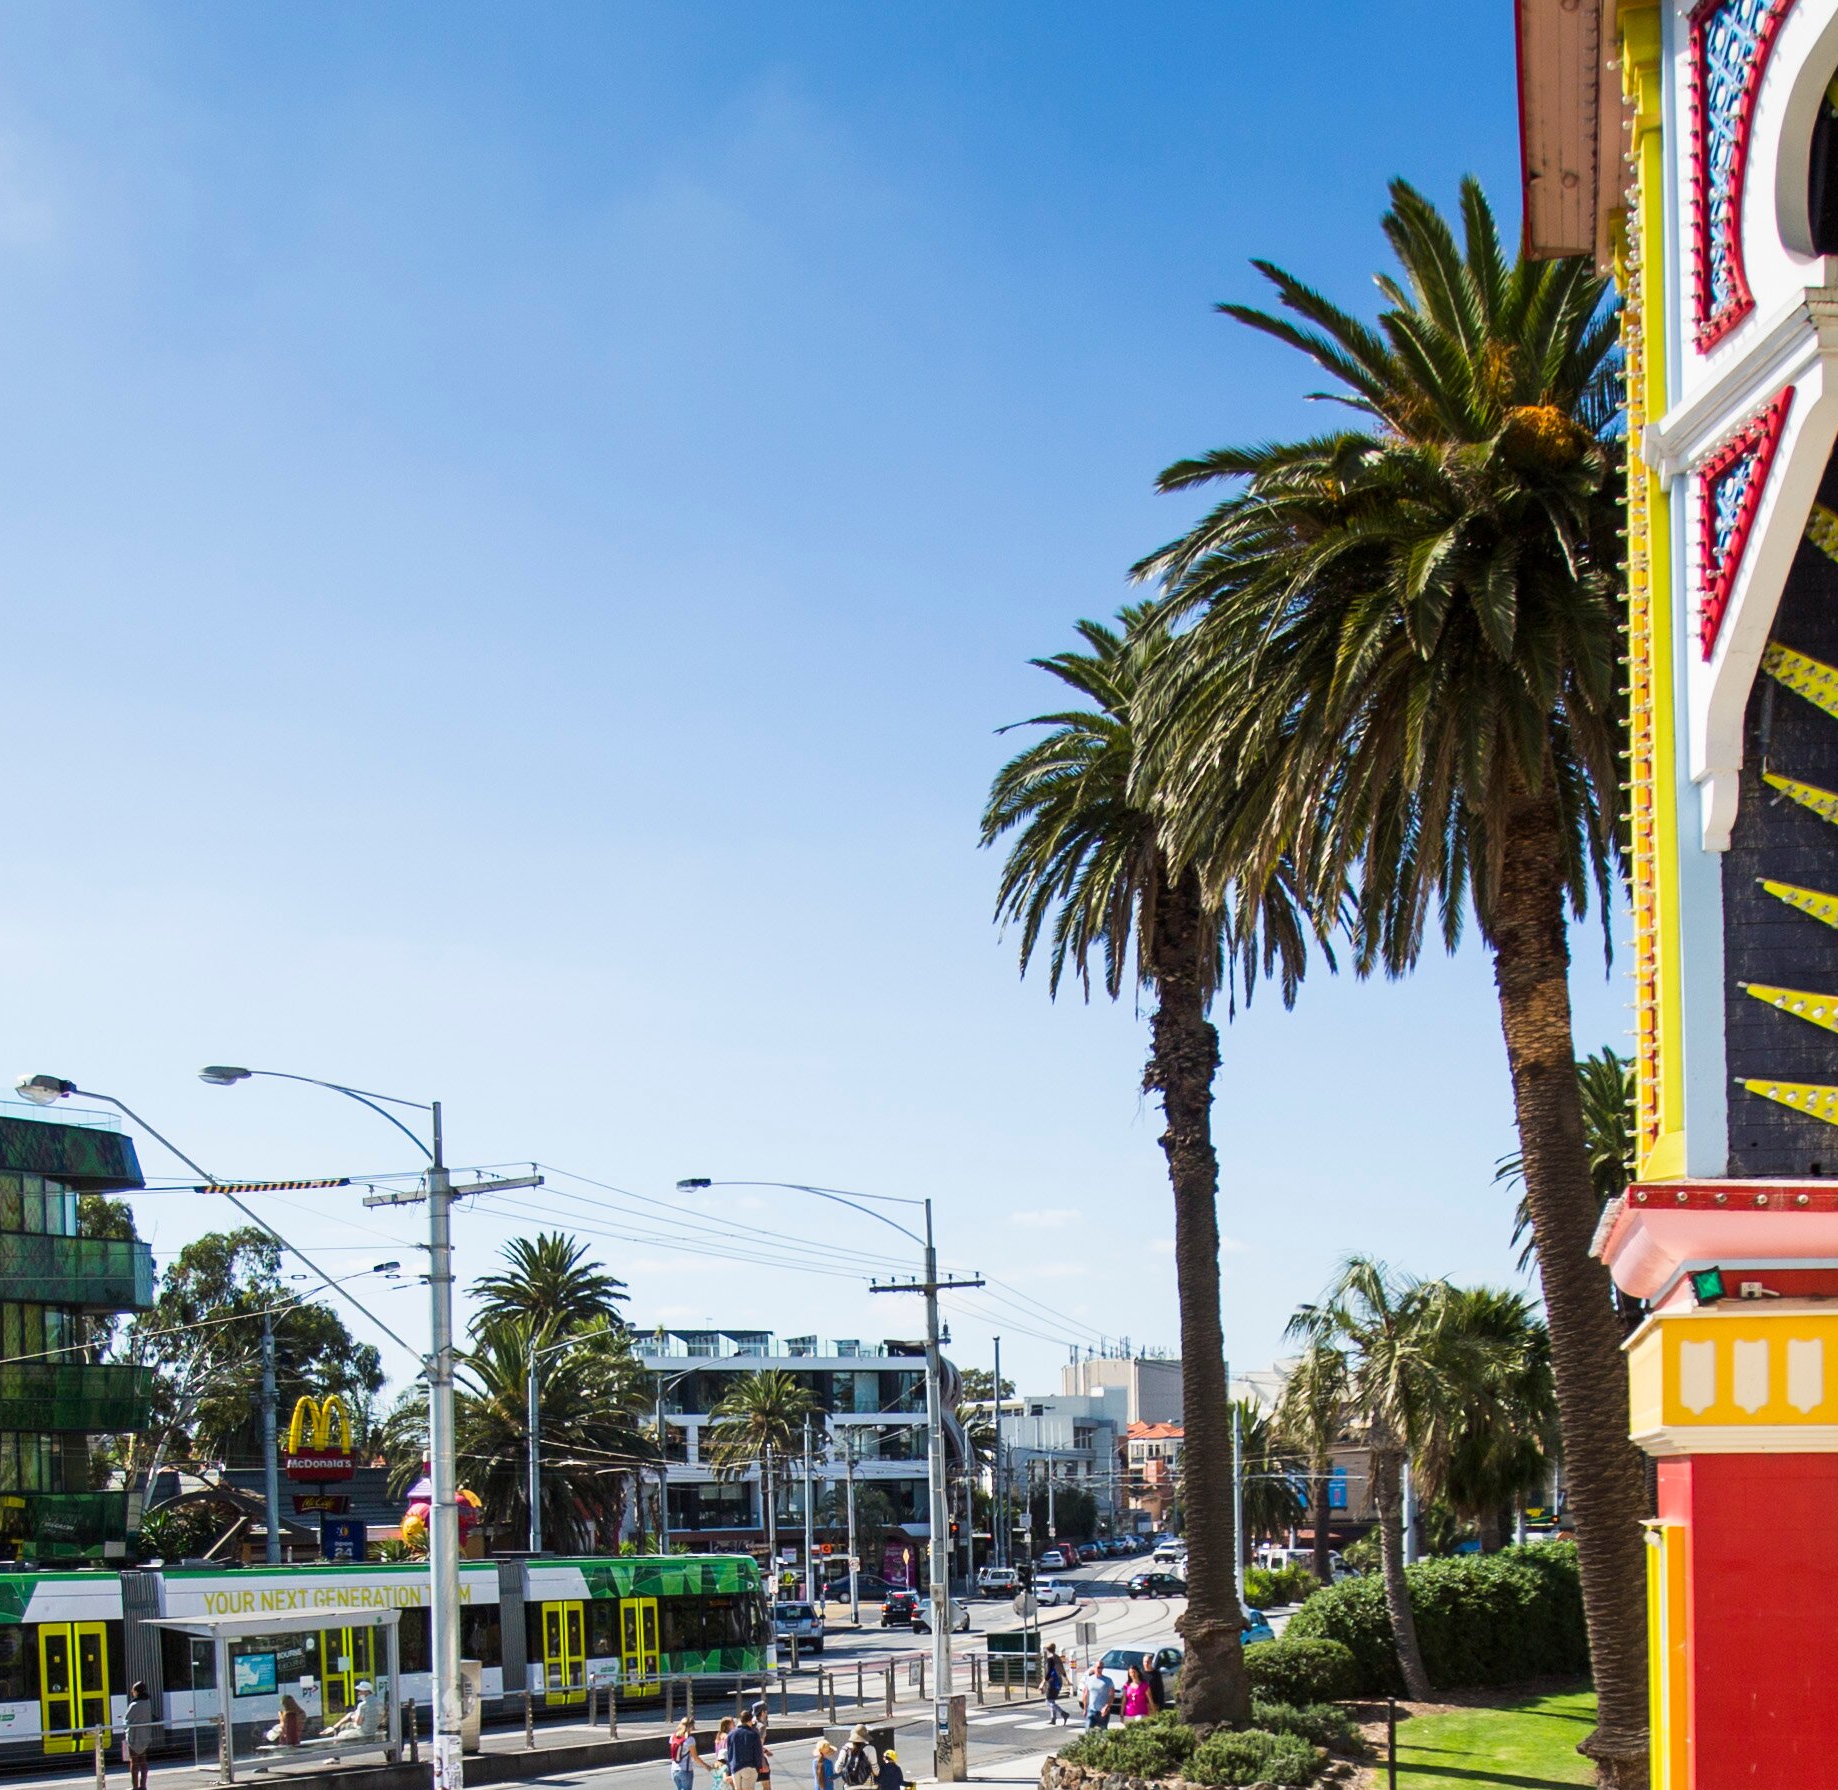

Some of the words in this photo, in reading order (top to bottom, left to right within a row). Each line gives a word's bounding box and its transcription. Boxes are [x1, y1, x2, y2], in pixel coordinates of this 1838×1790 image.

[287, 1459, 352, 1469] McDonald's
[334, 1547, 353, 1557] 24
[203, 1591, 256, 1615] YOUR
[260, 1589, 309, 1611] NEXT
[313, 1585, 421, 1608] GENERATION
